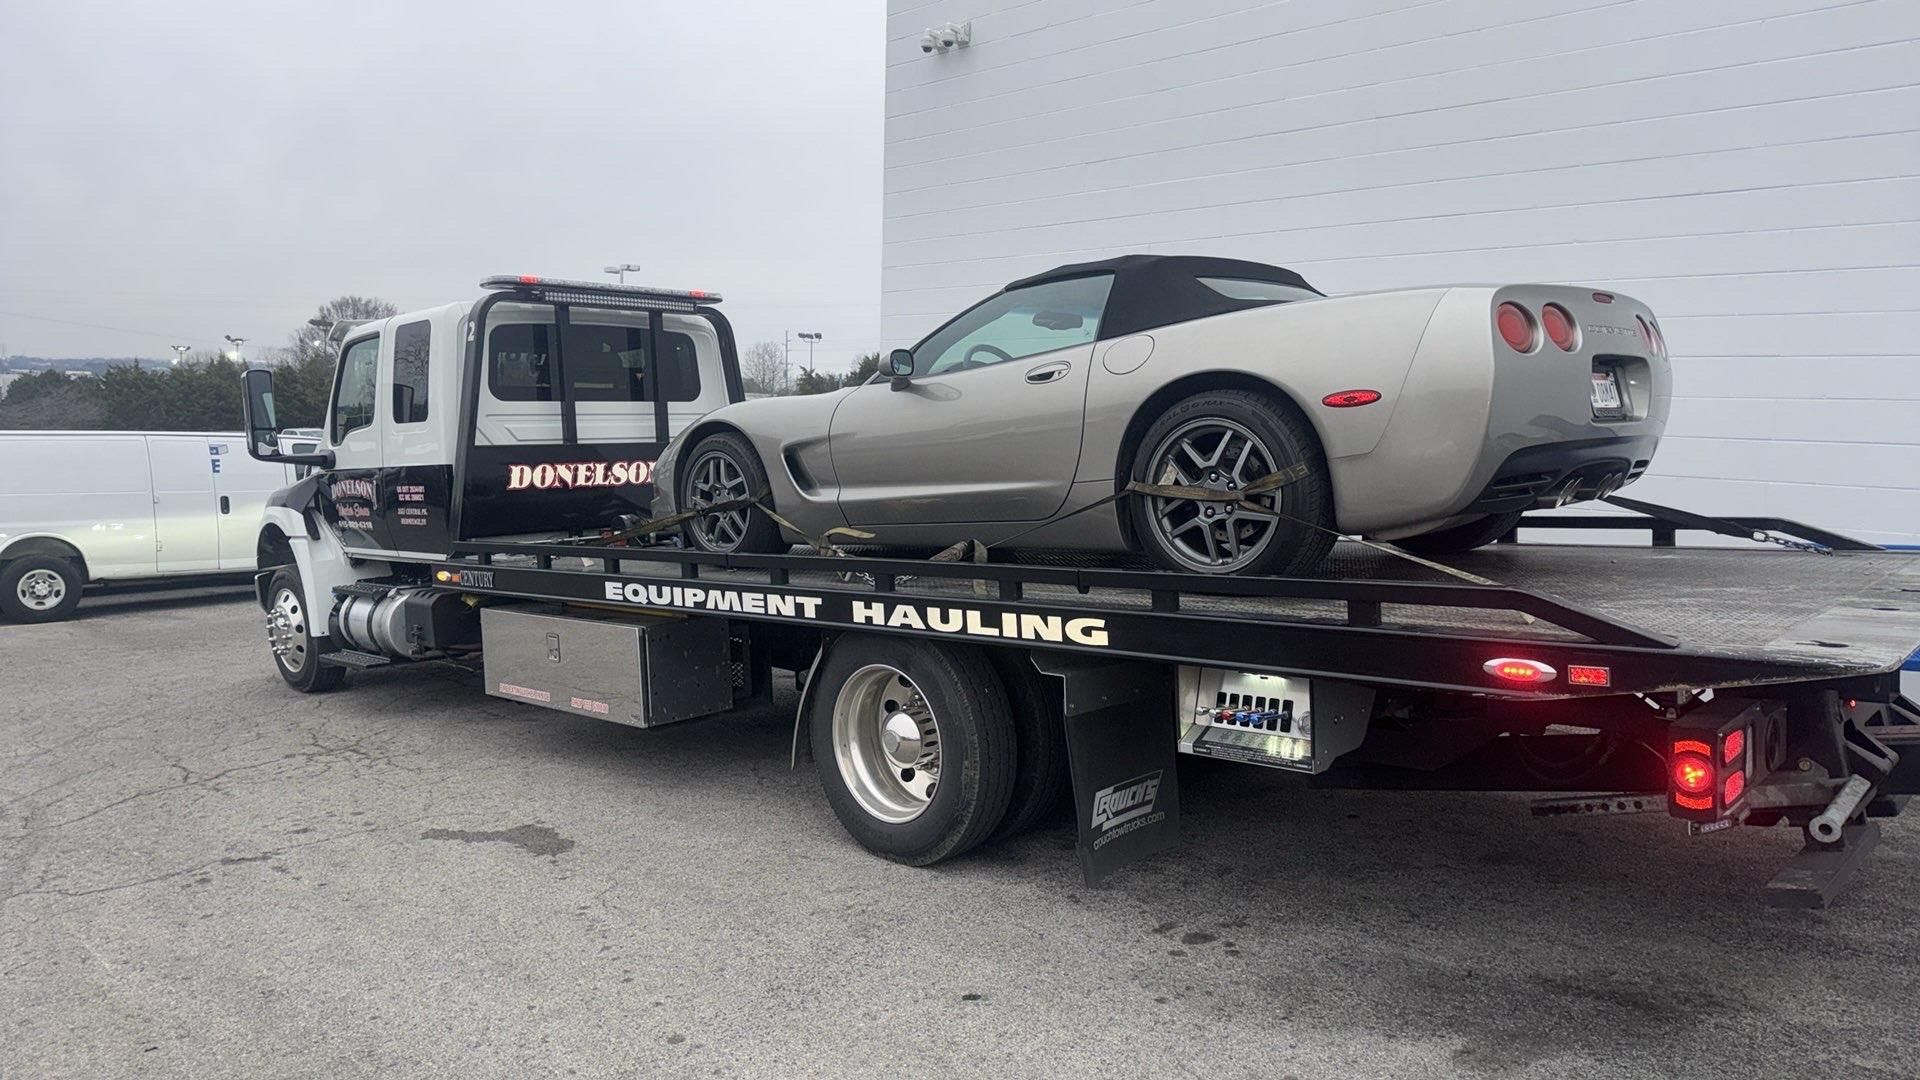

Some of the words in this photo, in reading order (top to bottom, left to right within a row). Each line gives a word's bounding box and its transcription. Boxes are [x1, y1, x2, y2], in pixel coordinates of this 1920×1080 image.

[468, 321, 475, 342] 2
[331, 480, 372, 502] DONELSON
[460, 570, 494, 588] CENTURY
[604, 581, 822, 619] EQUIPMENT
[852, 603, 1108, 647] HAULING
